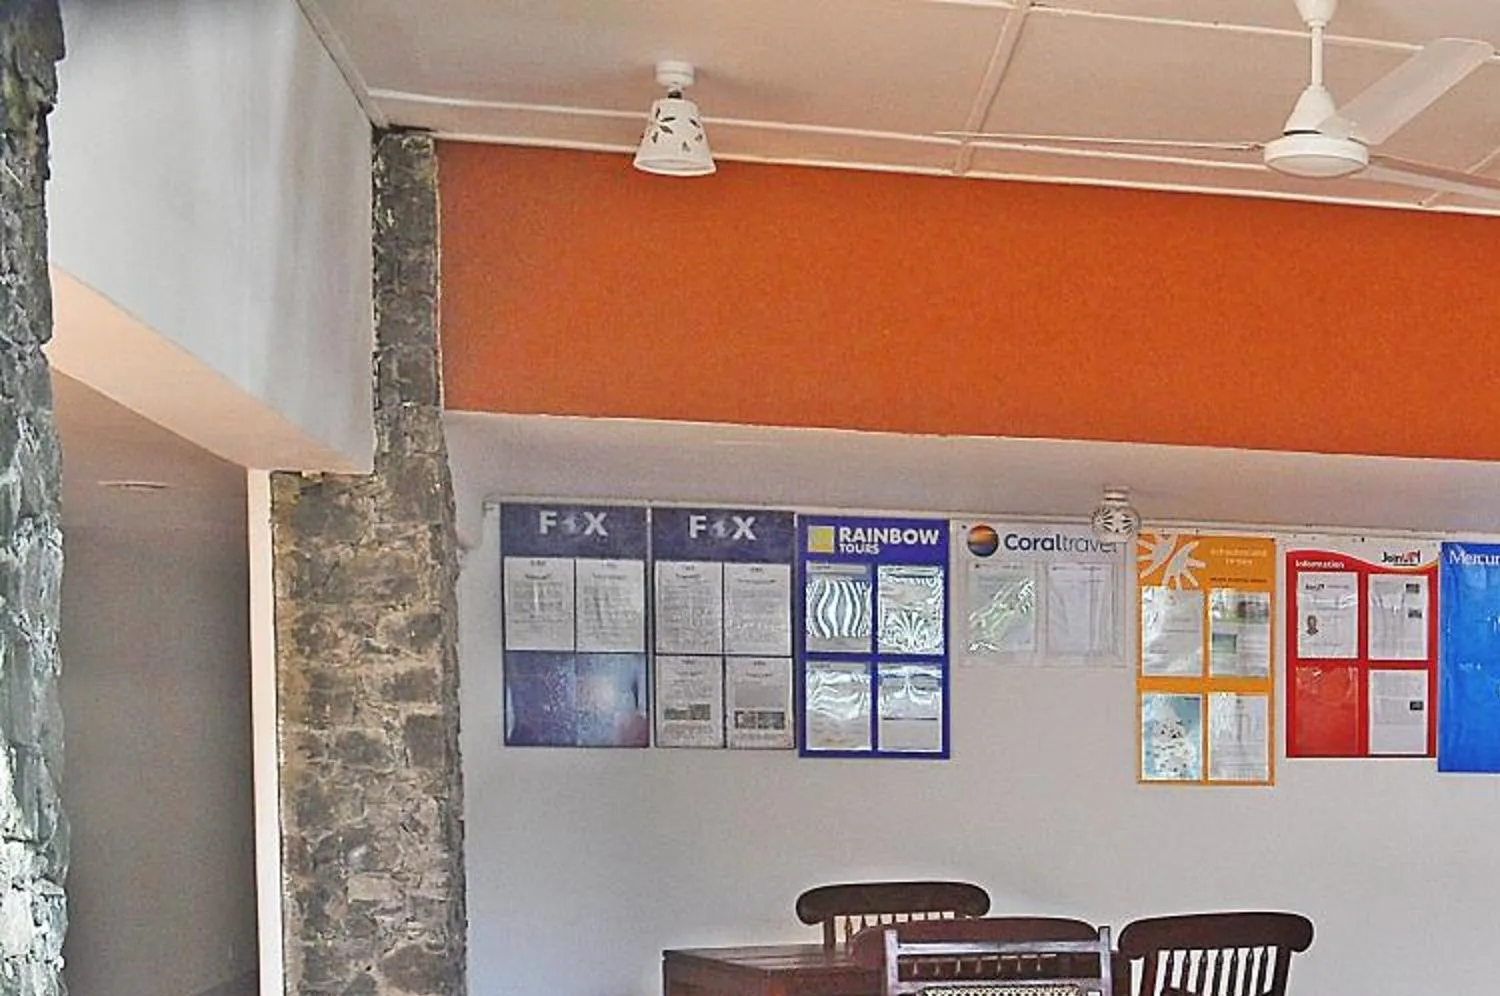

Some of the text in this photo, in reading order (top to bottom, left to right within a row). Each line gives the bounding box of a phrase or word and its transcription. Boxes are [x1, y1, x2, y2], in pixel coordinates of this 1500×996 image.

[839, 526, 939, 545] RAINBOW
[839, 543, 880, 555] TOURS
[1295, 559, 1345, 569] Information
